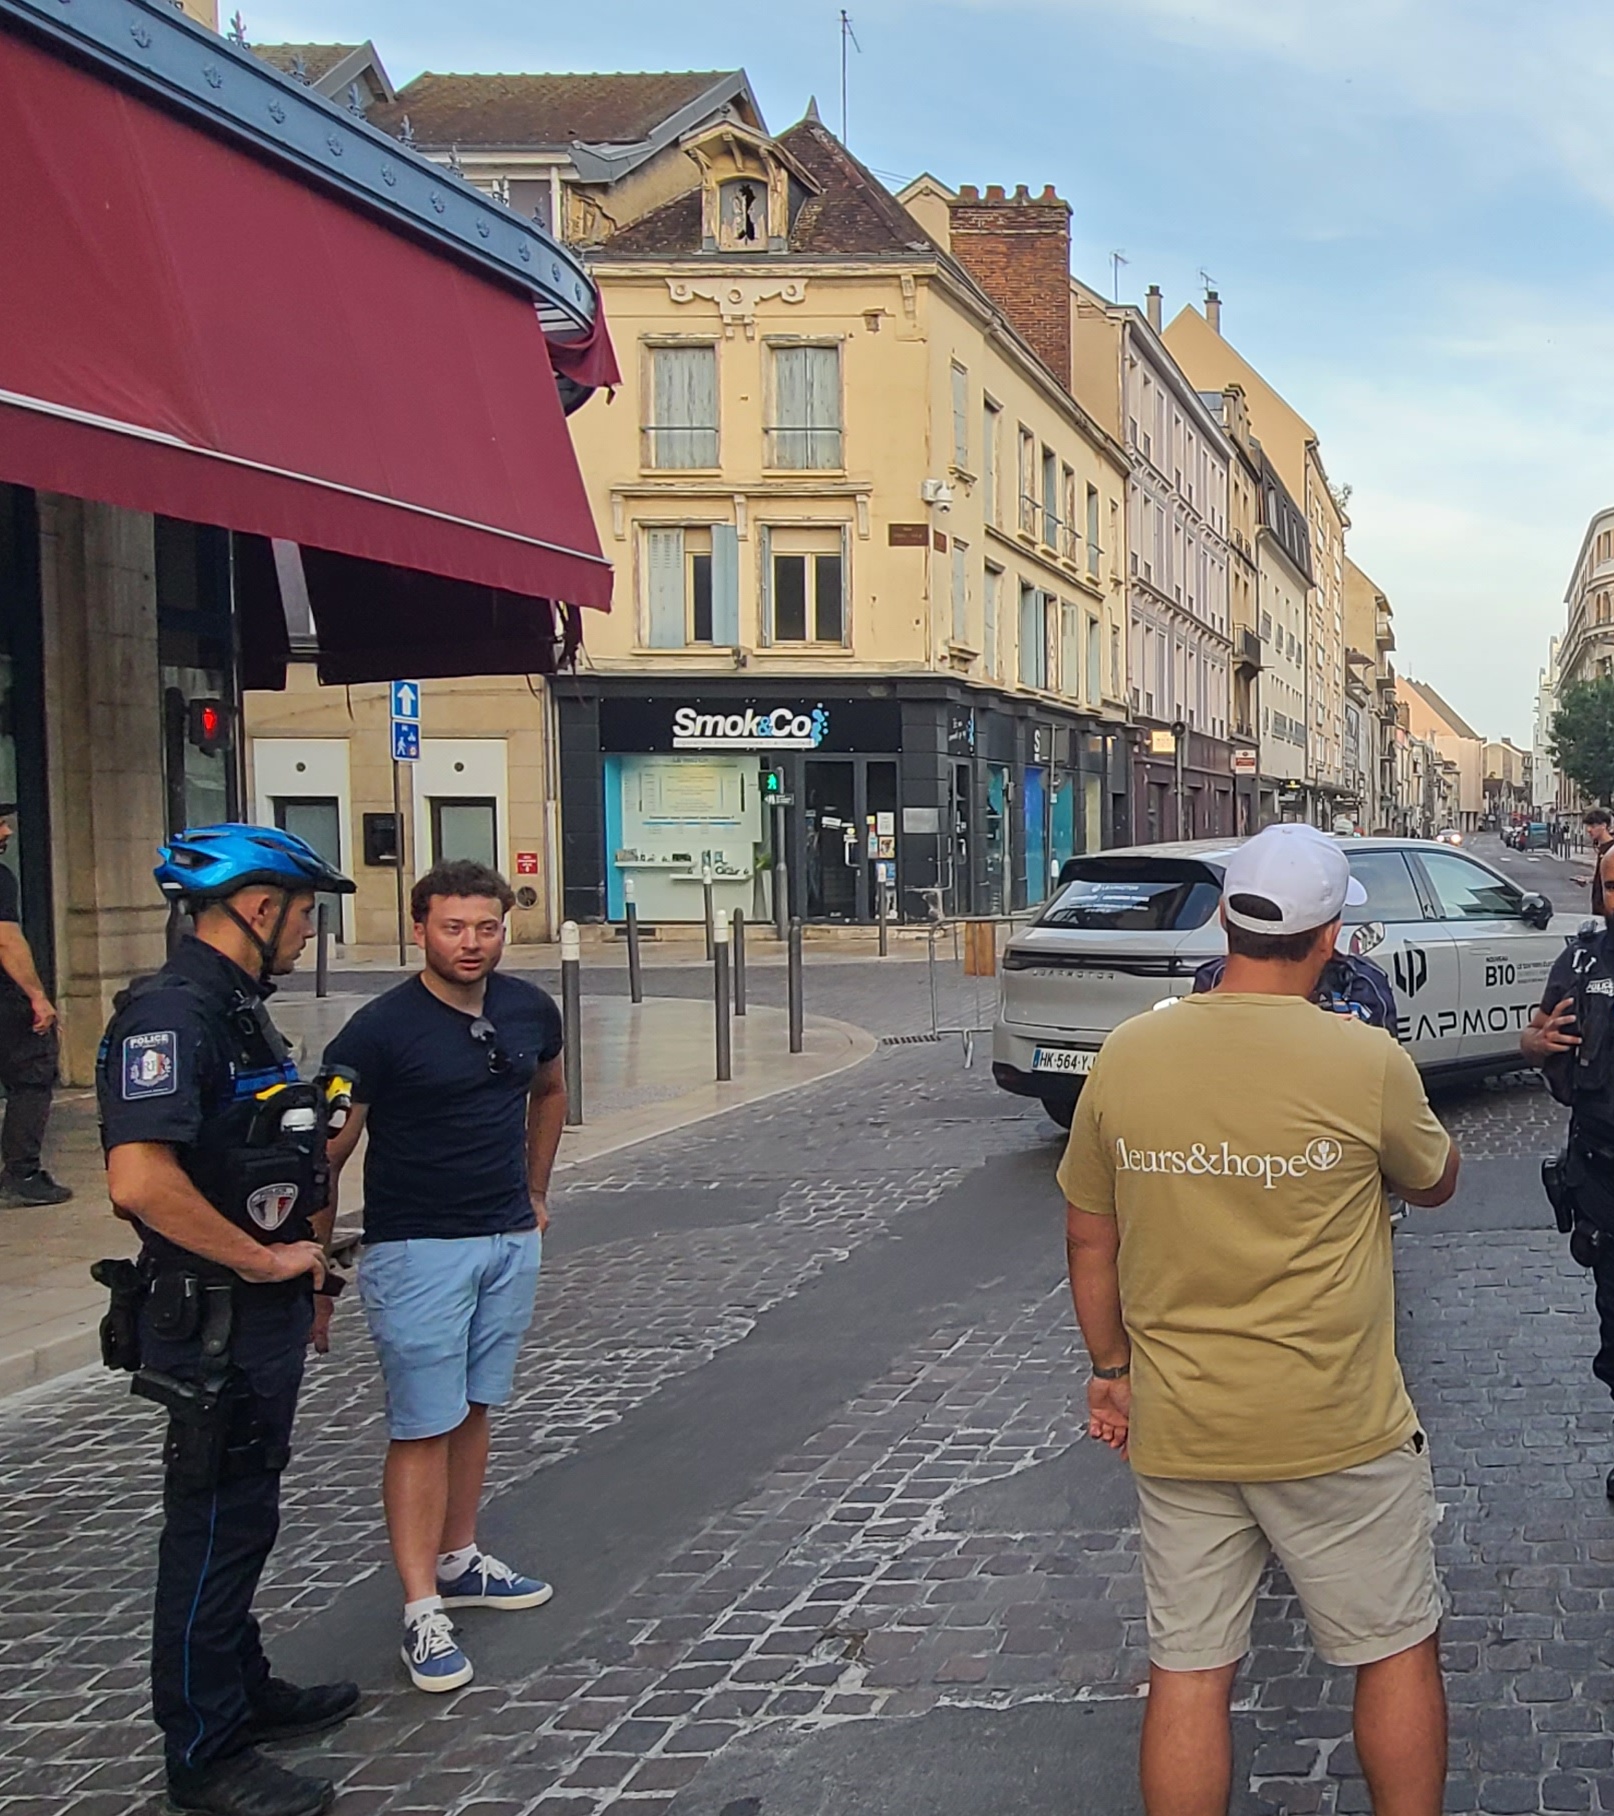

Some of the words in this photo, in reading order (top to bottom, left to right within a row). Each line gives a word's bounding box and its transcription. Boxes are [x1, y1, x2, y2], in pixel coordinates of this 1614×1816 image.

[672, 707, 812, 737] Smok&Co
[1486, 964, 1515, 987] B10
[130, 1034, 169, 1049] POLICE
